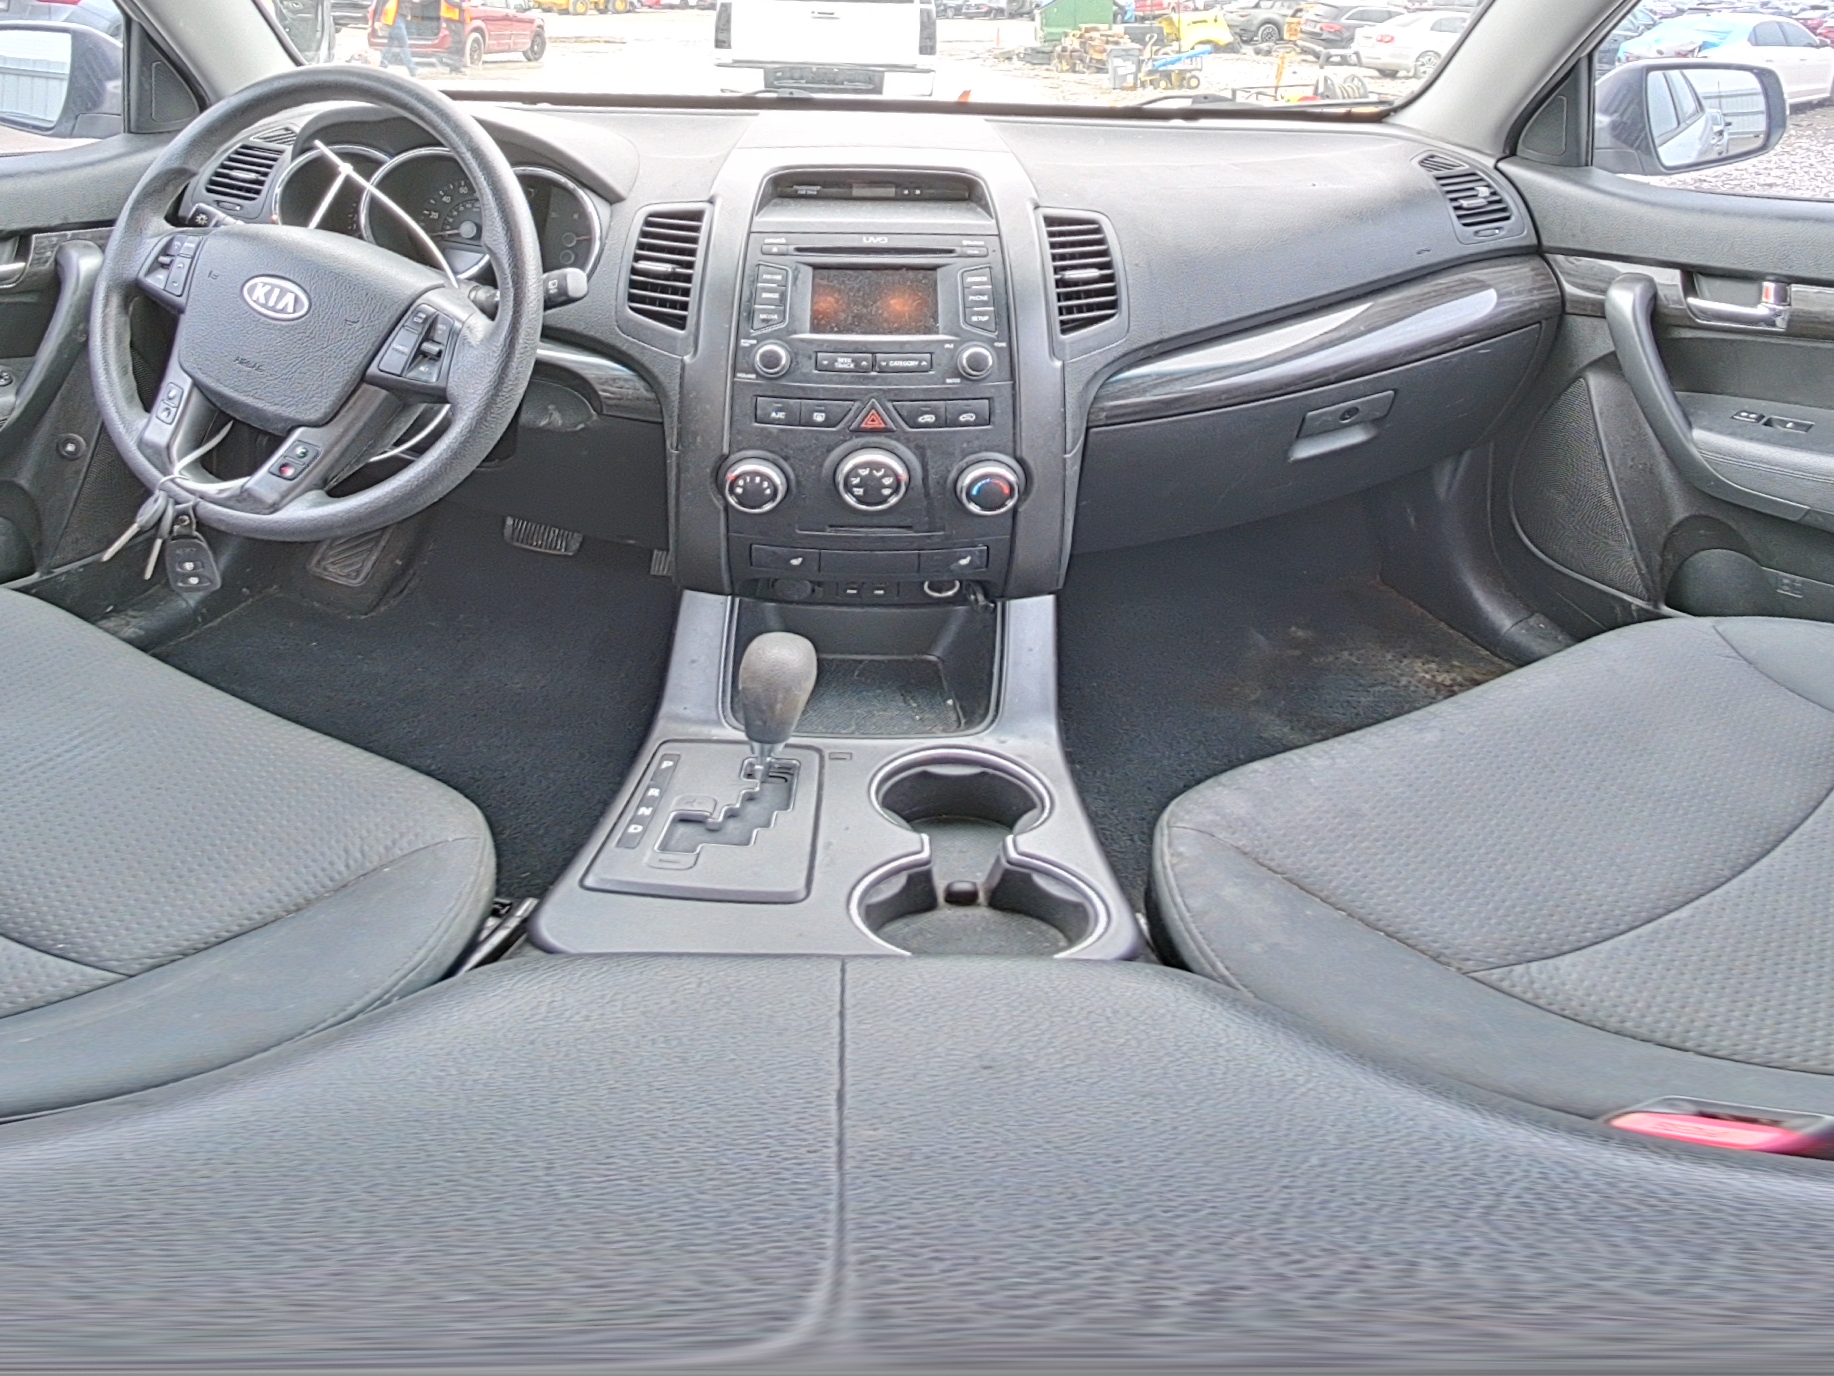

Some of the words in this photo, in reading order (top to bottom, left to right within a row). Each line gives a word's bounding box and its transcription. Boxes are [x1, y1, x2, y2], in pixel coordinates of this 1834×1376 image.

[459, 186, 468, 194] 60
[442, 195, 451, 203] 40
[252, 283, 297, 314] KIA
[770, 411, 786, 419] A/C
[661, 760, 674, 769] P
[647, 787, 661, 797] R
[637, 807, 653, 815] N
[627, 824, 644, 833] D
